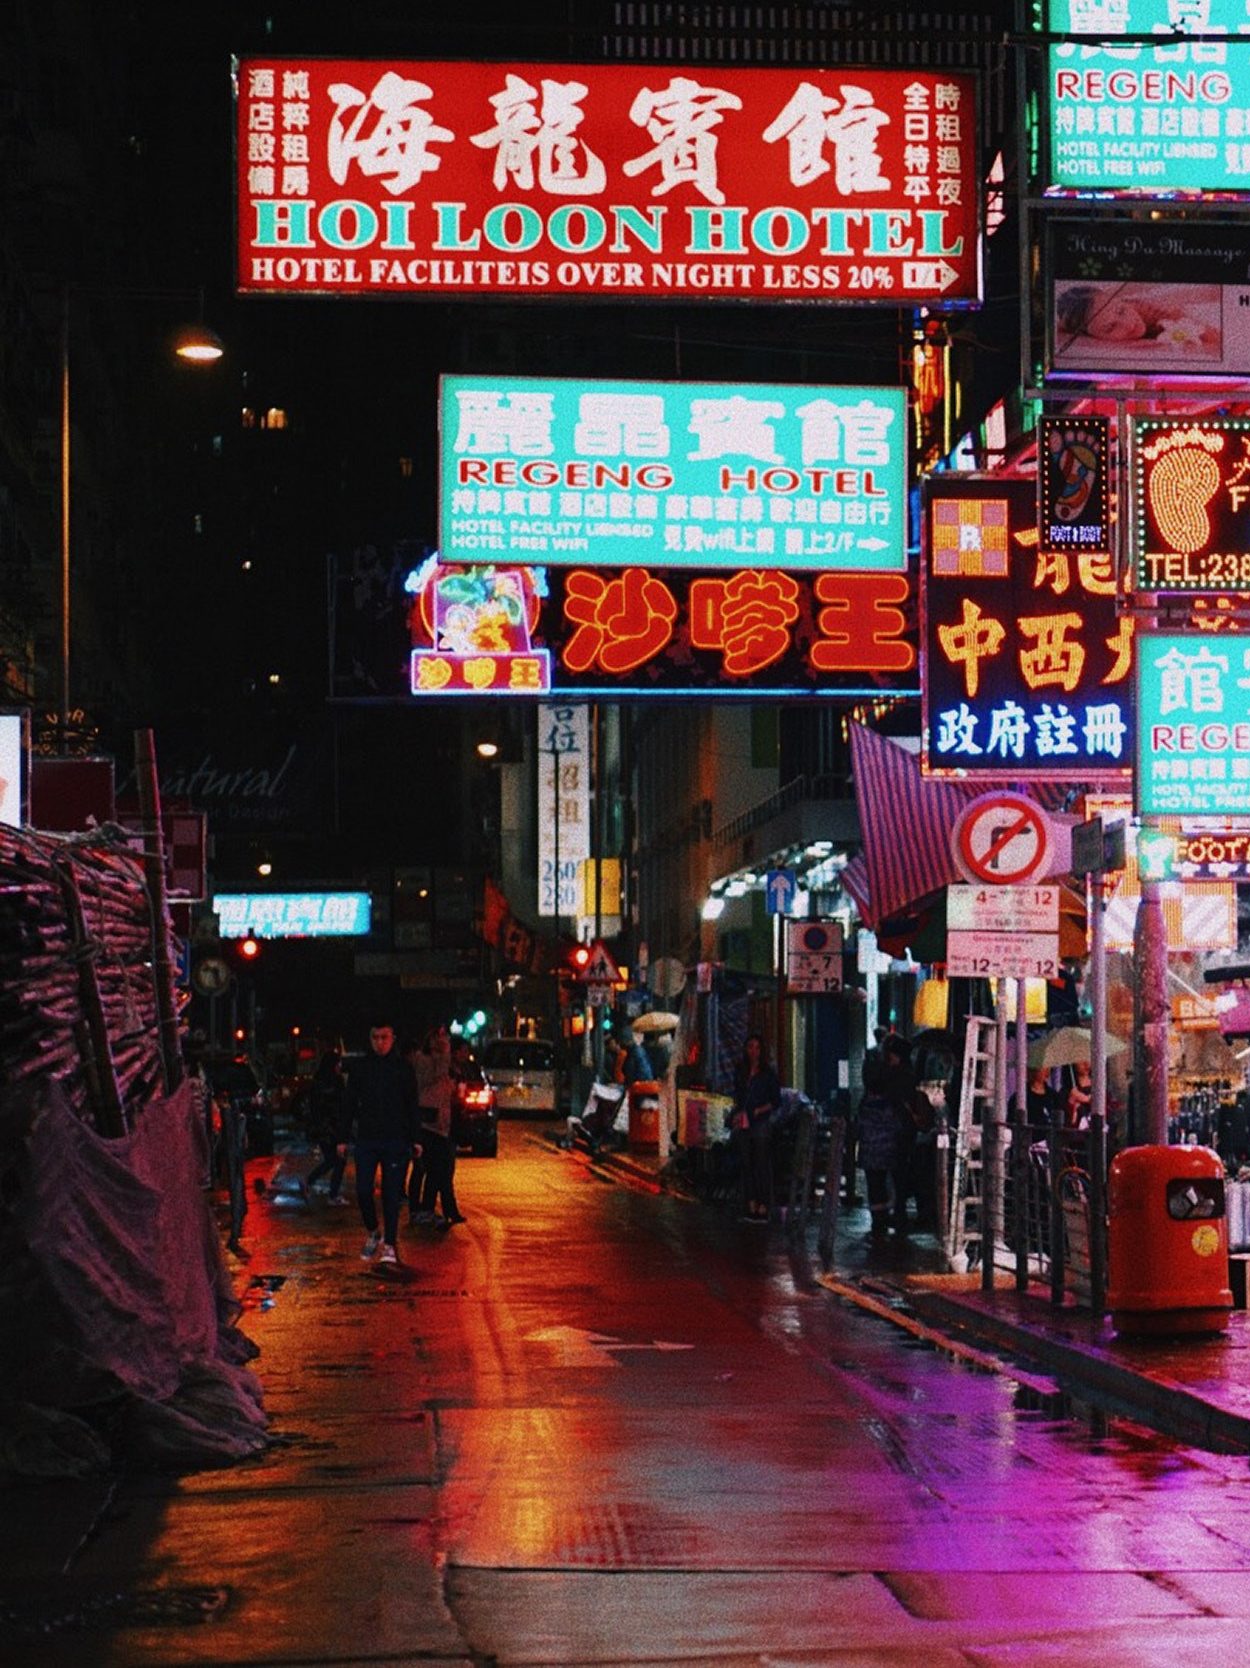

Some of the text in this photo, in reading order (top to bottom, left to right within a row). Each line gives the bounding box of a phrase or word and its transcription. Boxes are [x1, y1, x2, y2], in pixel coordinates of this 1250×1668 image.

[1055, 70, 1232, 102] REGENG
[327, 71, 891, 205] 海龍賓館
[1056, 142, 1100, 157] HOTEL
[1056, 160, 1101, 176] HOTEL
[251, 199, 964, 257] HOI LOON HOTEL
[1158, 237, 1245, 264] Massage
[251, 258, 364, 283] HOTEL
[369, 259, 550, 286] FACILITEIS
[557, 261, 644, 287] OVER
[652, 263, 756, 288] NIGHT
[763, 264, 841, 289] LESS
[848, 264, 895, 290] 20%
[453, 390, 895, 465] 麗晶賓館
[457, 458, 888, 497] REGENG HOTEL
[451, 519, 505, 534] HOTEL
[510, 520, 582, 535] FACILITY
[451, 535, 505, 549] HOTEL
[510, 536, 548, 551] FREE
[936, 701, 1128, 759] 政府註冊
[1175, 840, 1242, 863] FOOT
[1034, 891, 1052, 905] 12
[972, 959, 990, 972] 12
[1036, 960, 1054, 974] 12
[824, 978, 840, 991] 12
